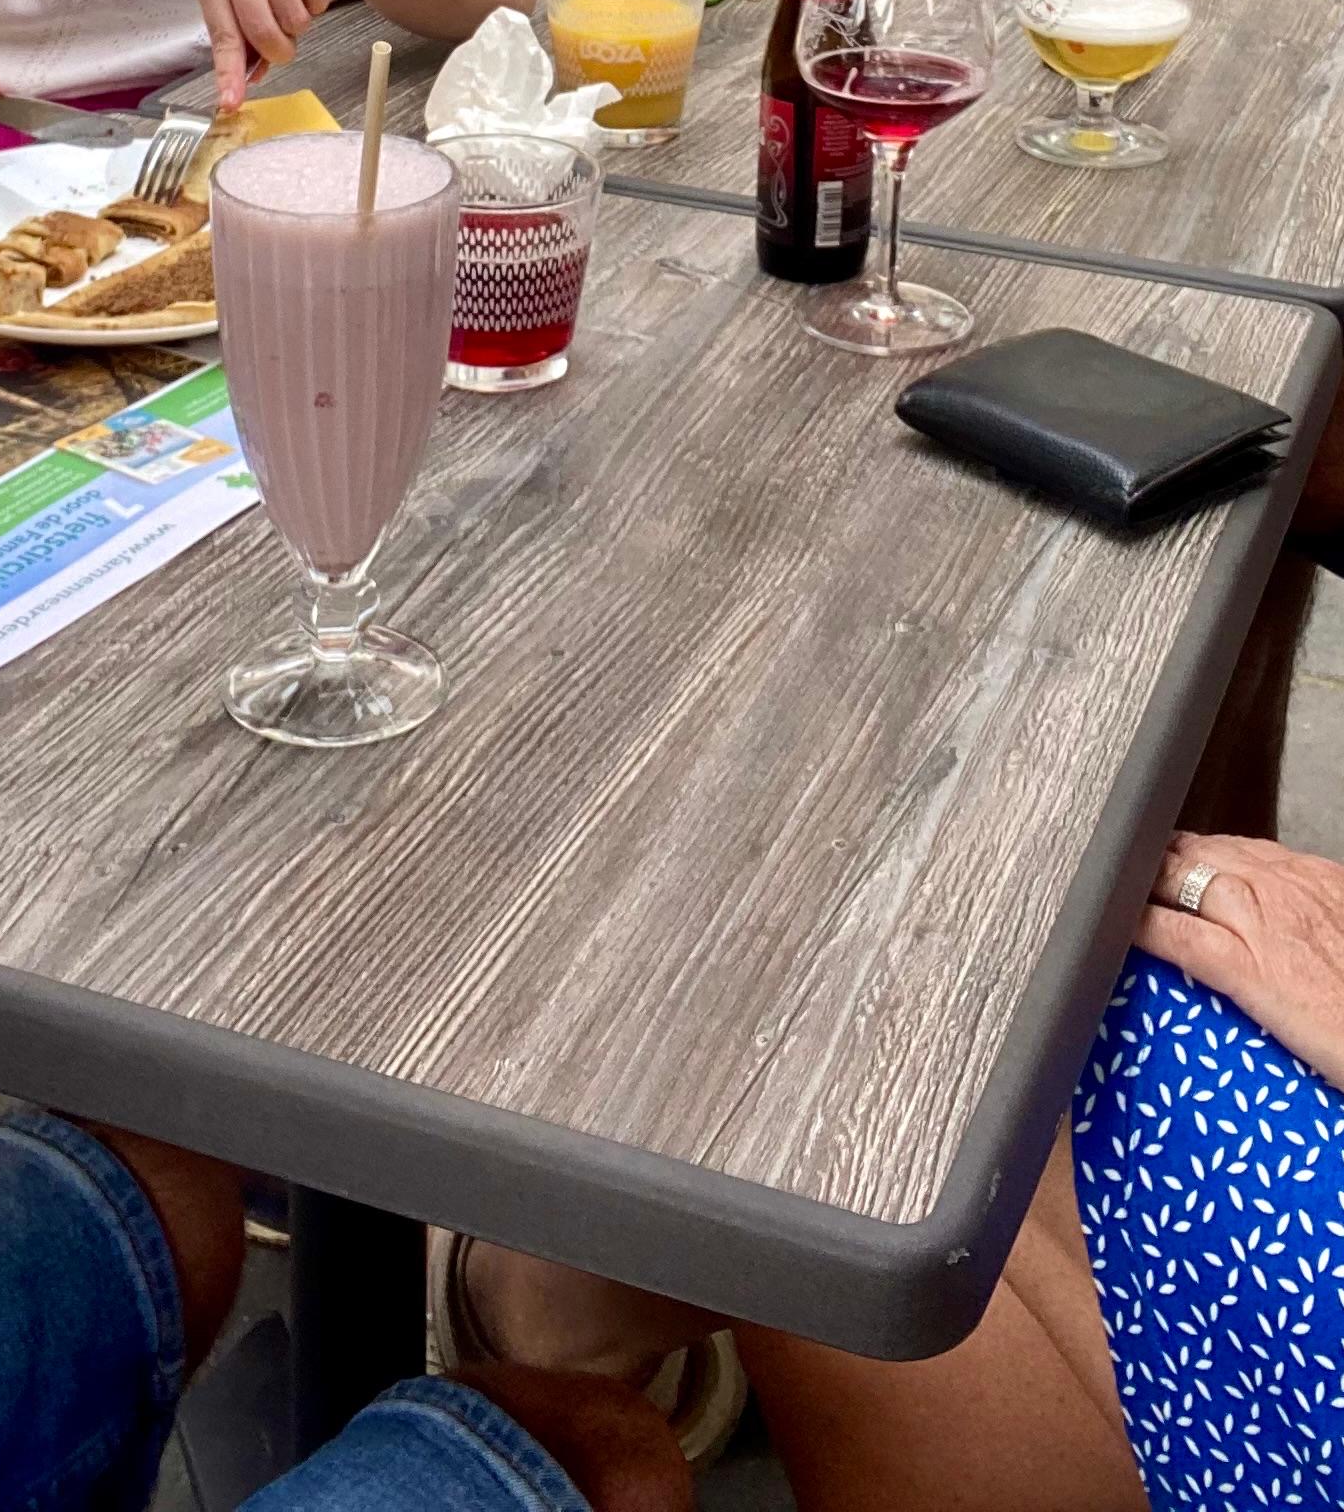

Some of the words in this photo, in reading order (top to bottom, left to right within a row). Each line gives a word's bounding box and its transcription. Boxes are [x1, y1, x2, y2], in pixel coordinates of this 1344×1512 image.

[579, 38, 647, 64] LOOZA
[61, 488, 103, 515] door
[34, 512, 61, 530] de
